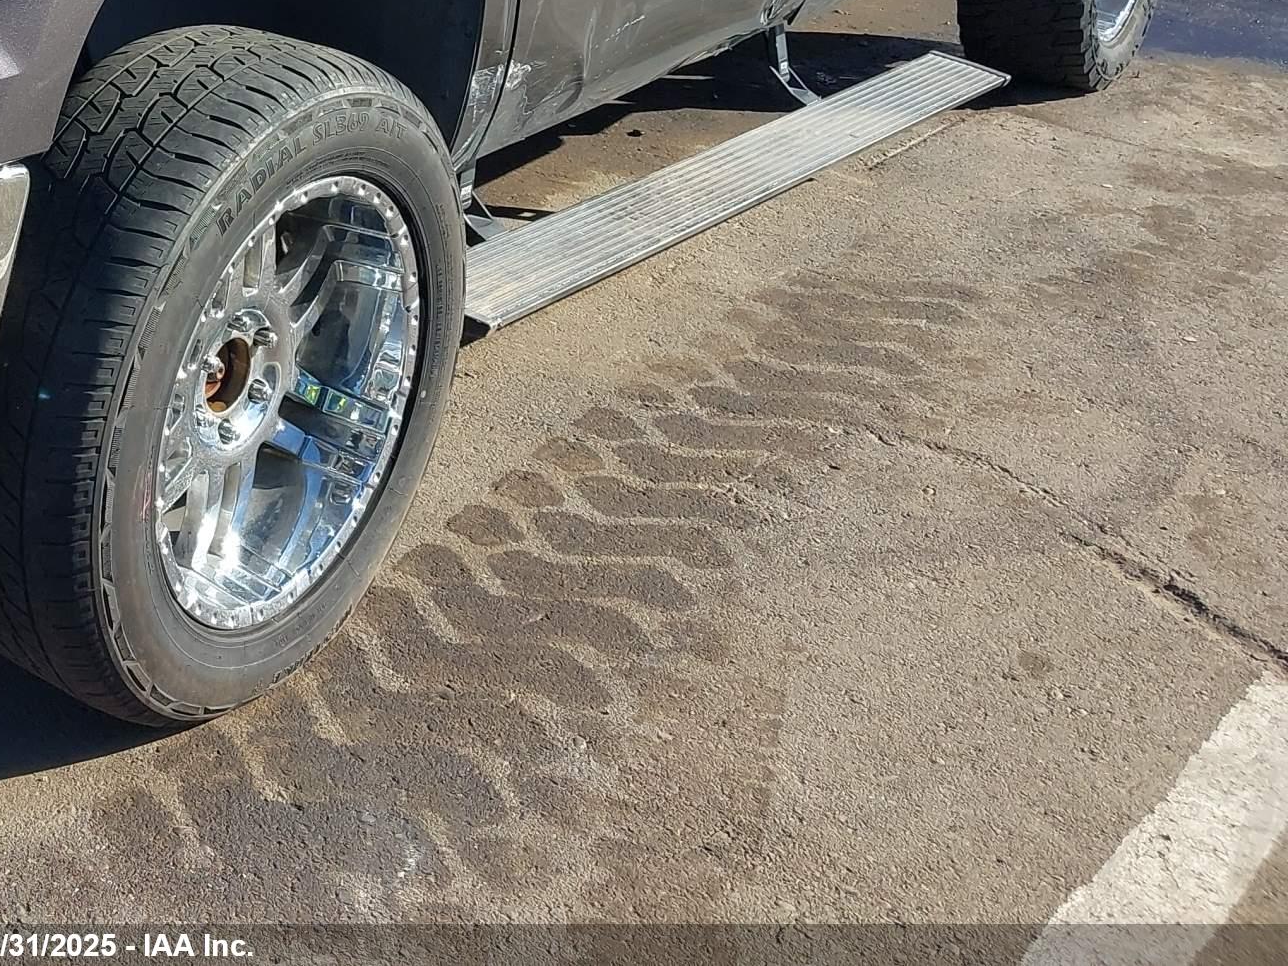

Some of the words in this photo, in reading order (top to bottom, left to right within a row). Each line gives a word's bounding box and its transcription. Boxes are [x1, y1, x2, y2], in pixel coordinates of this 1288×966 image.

[215, 137, 307, 236] RADIAL
[312, 112, 369, 146] SL369
[375, 116, 408, 140] A/T
